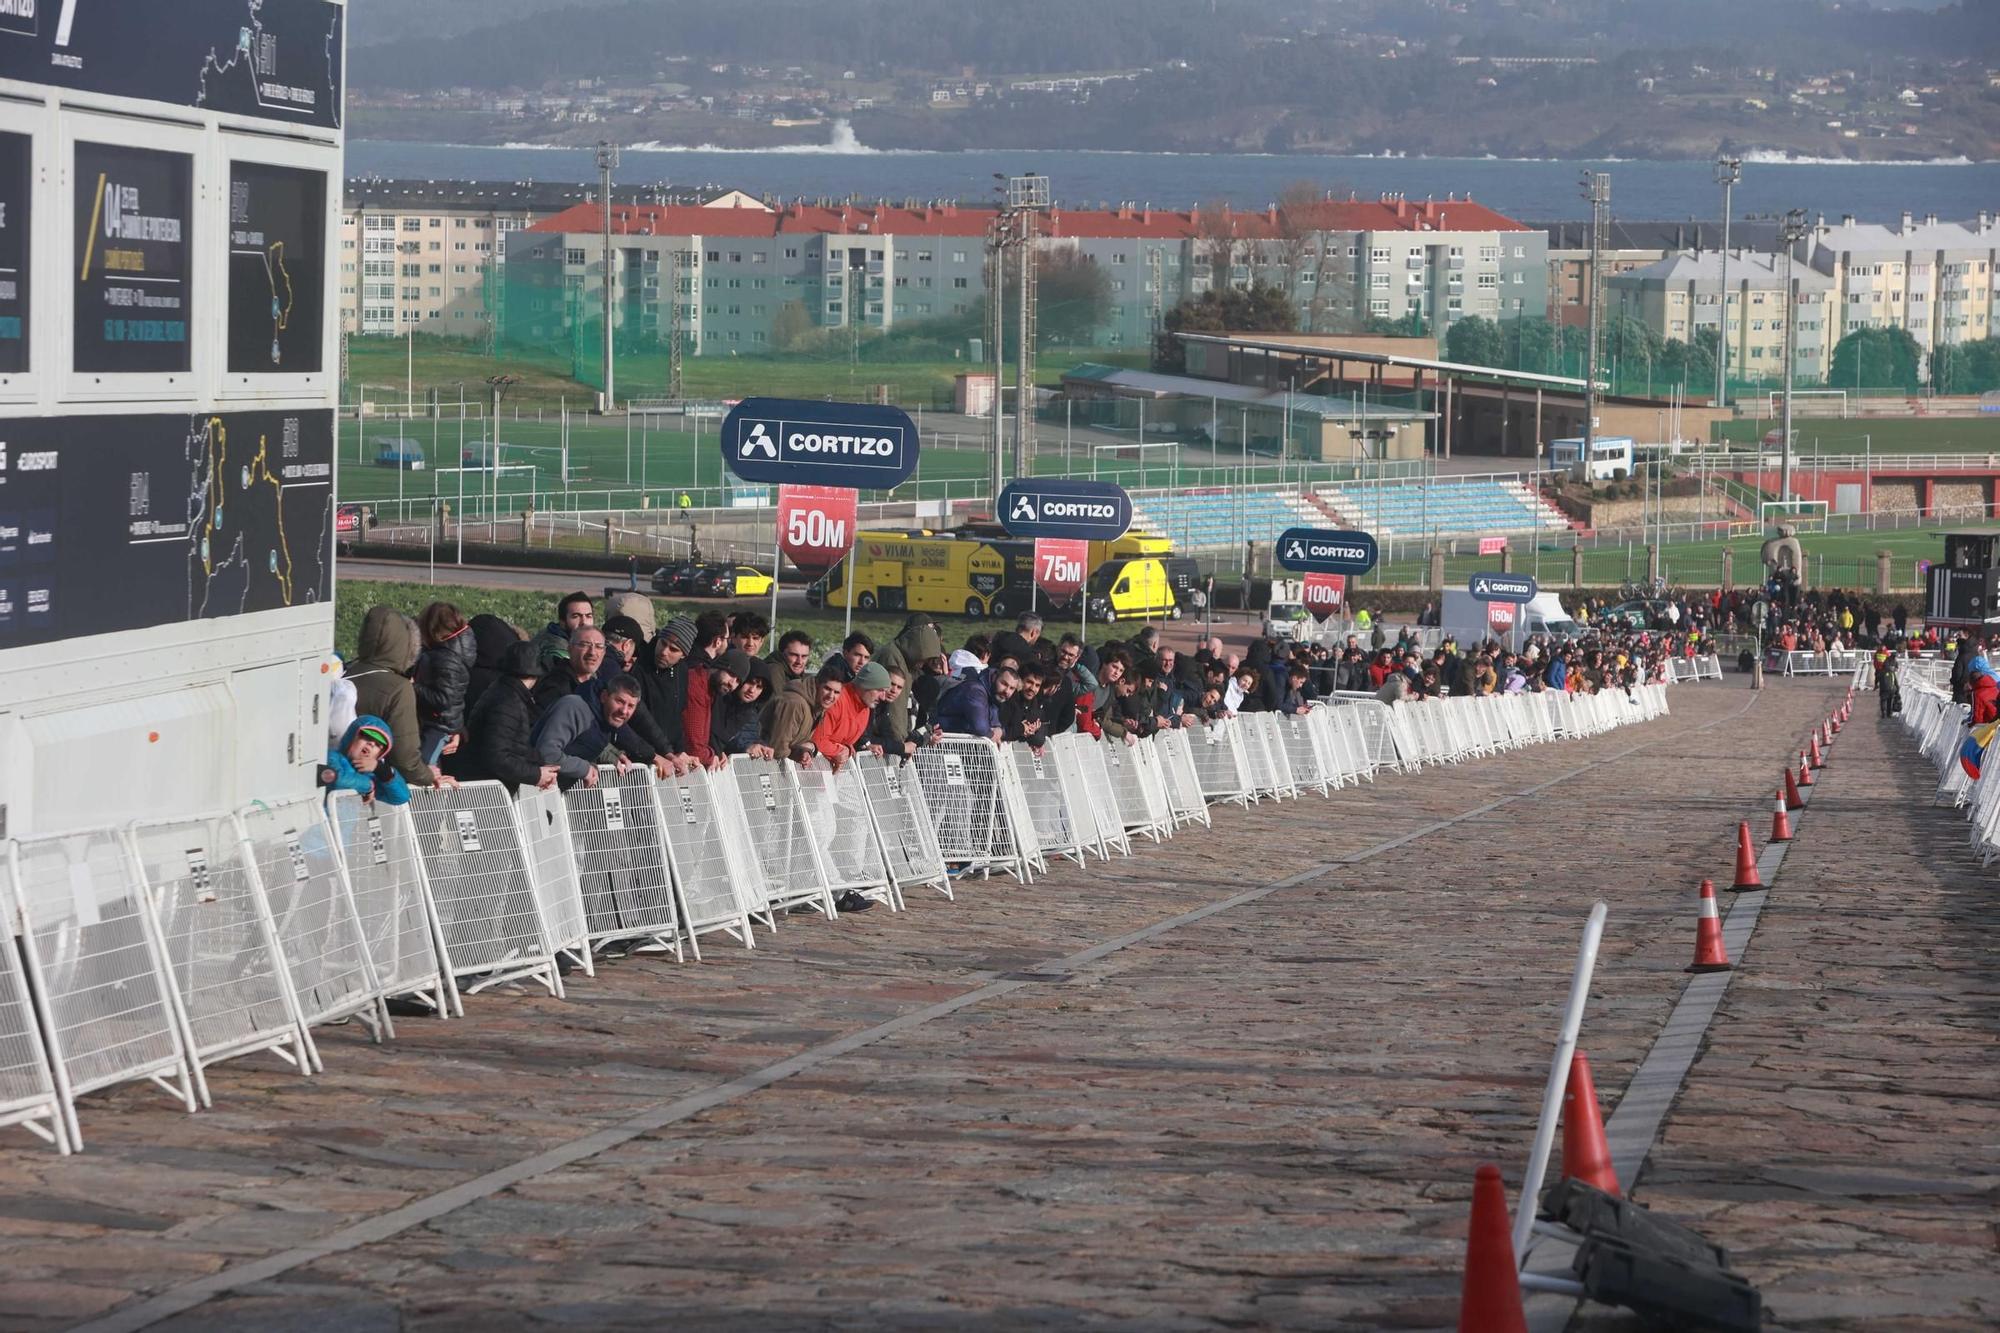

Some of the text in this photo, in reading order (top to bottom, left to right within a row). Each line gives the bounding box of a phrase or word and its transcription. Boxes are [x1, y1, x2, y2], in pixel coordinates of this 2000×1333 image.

[104, 182, 121, 239] 04
[788, 433, 894, 457] CORTIZO
[1043, 502, 1115, 518] CORTIZO
[788, 509, 845, 548] 50M
[884, 544, 914, 558] VISMA
[1310, 546, 1365, 559] CORTIZO
[981, 560, 1001, 568] VISMA
[1042, 555, 1081, 582] 75M
[1307, 585, 1340, 605] 100M
[1491, 583, 1529, 593] CORTIZO
[1490, 610, 1513, 623] 150M
